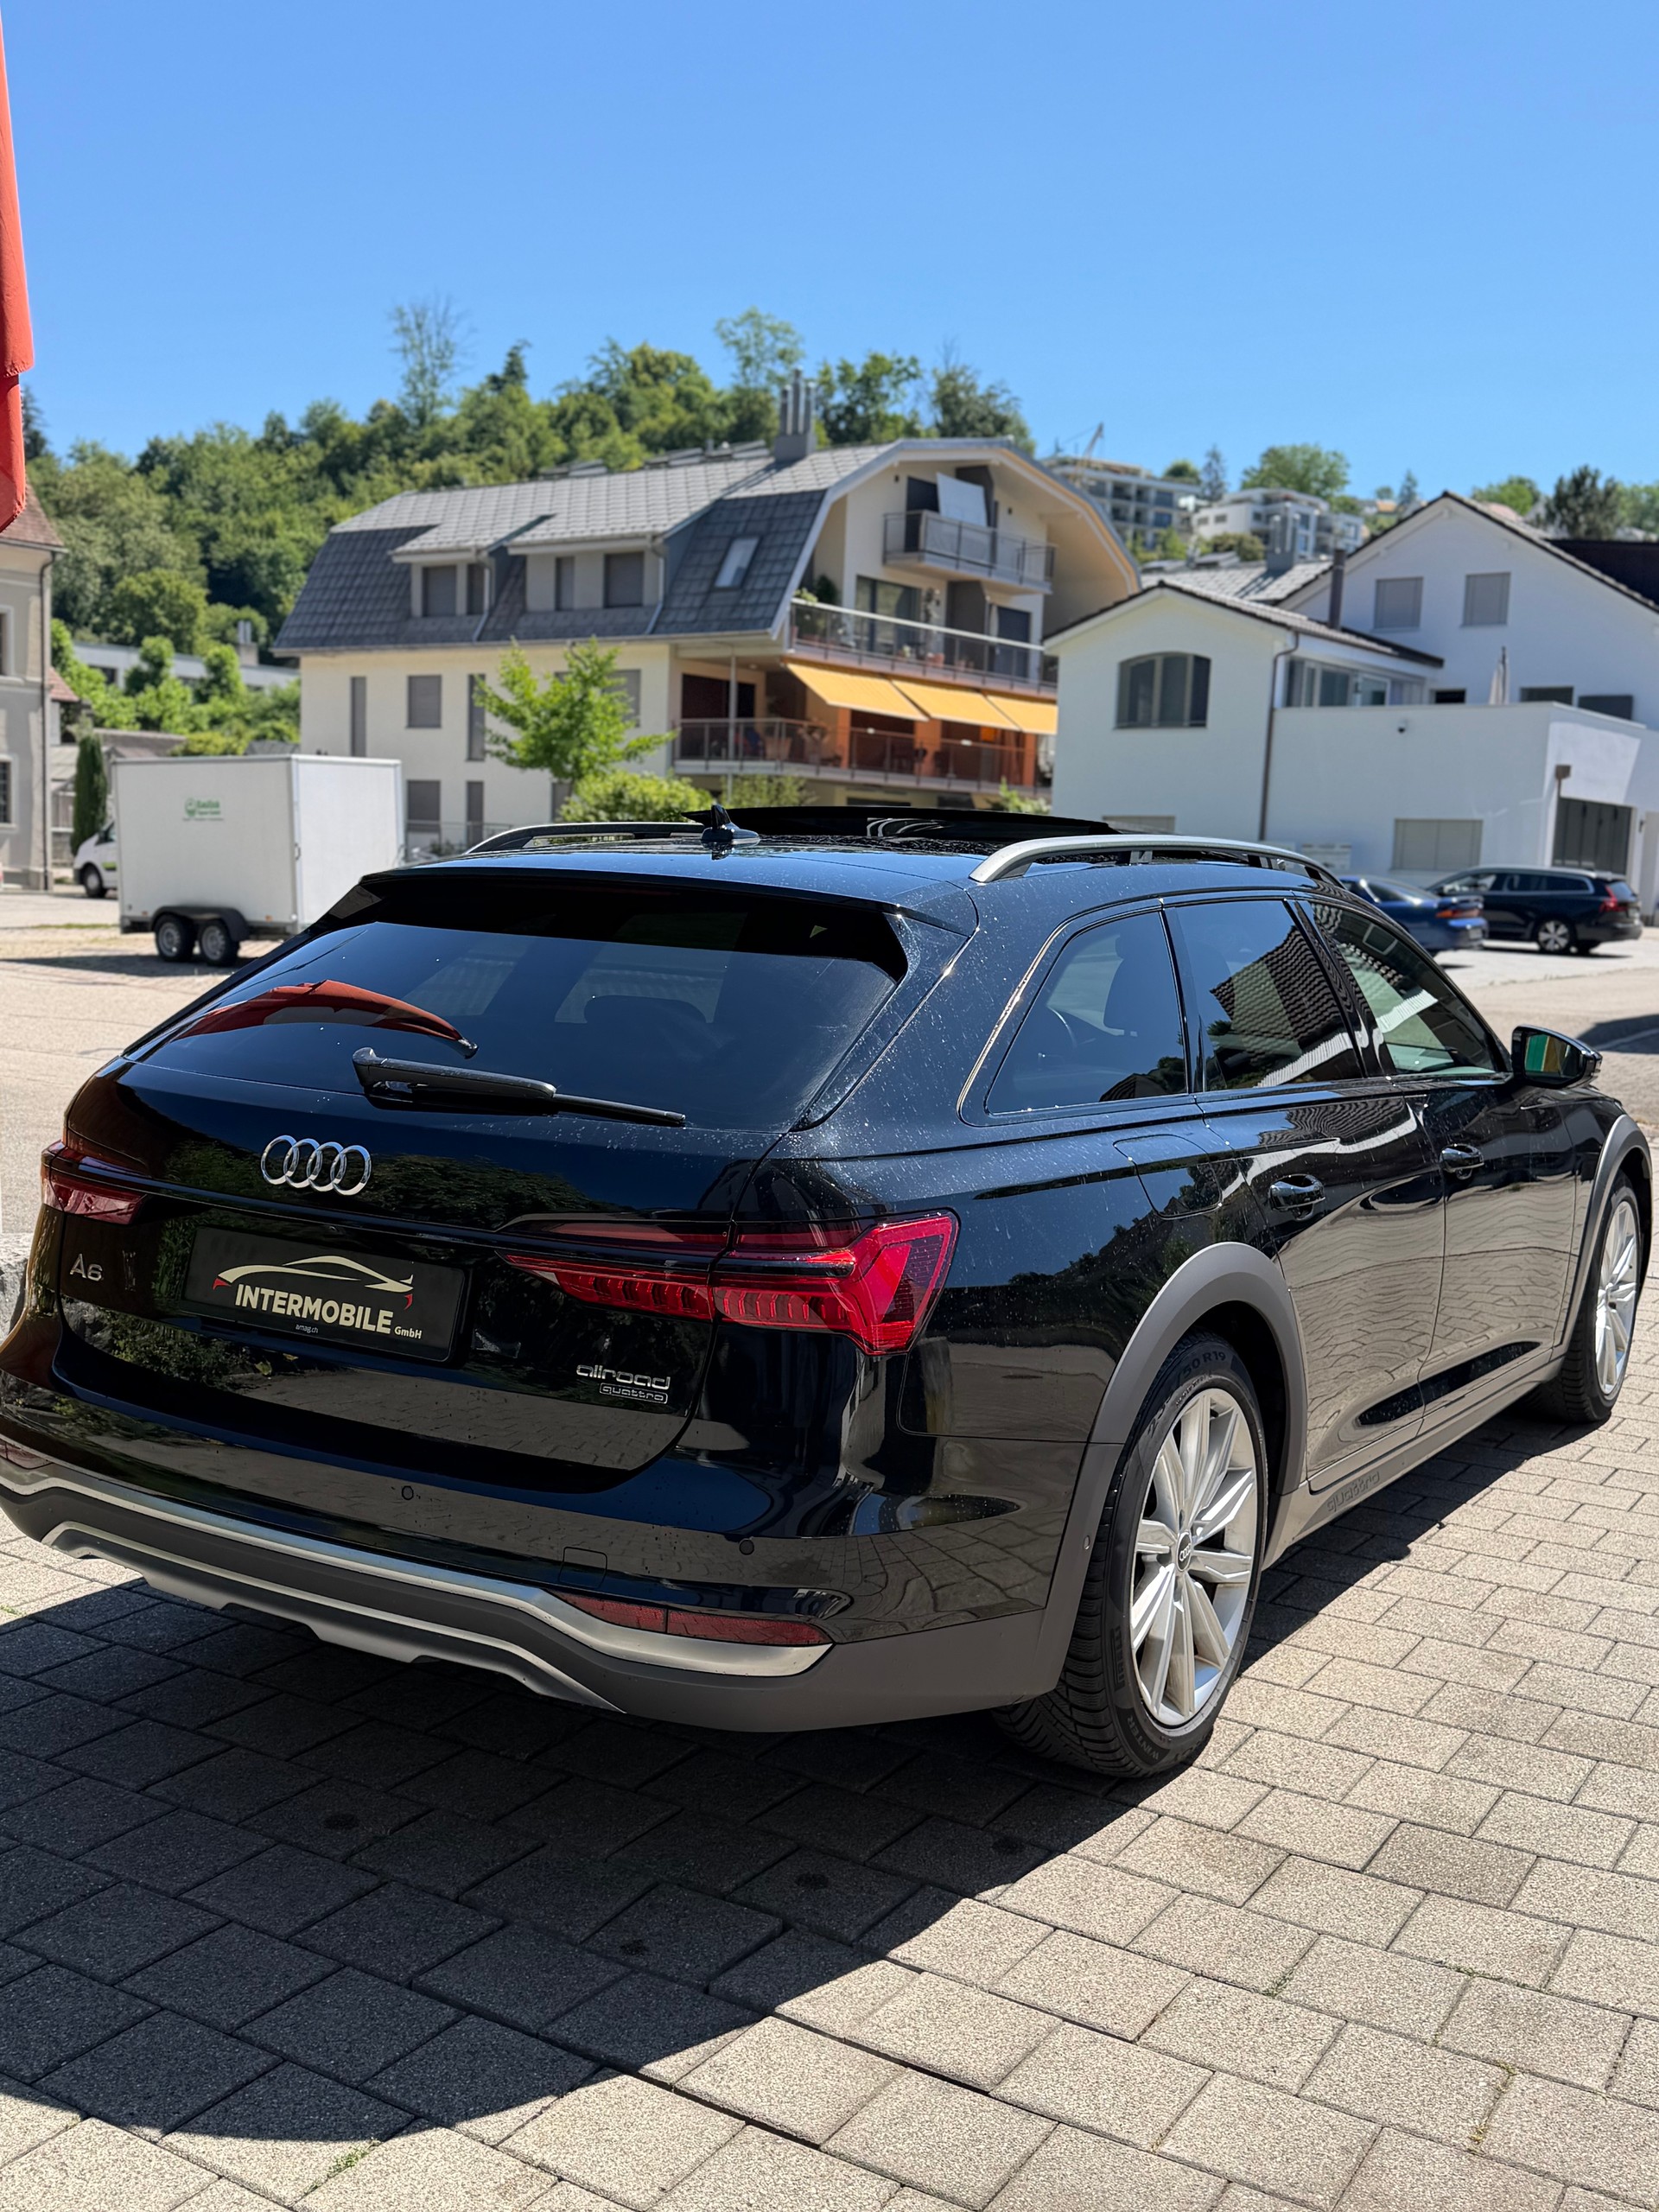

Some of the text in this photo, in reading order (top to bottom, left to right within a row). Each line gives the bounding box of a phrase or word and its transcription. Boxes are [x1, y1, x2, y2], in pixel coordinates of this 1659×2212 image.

[70, 1253, 103, 1281] A6
[235, 1283, 423, 1339] INTERMOBILE GmbH
[575, 1364, 671, 1390] allroad
[602, 1385, 664, 1402] quattro
[1326, 1471, 1381, 1512] quattro
[1127, 1714, 1160, 1760] WINTER
